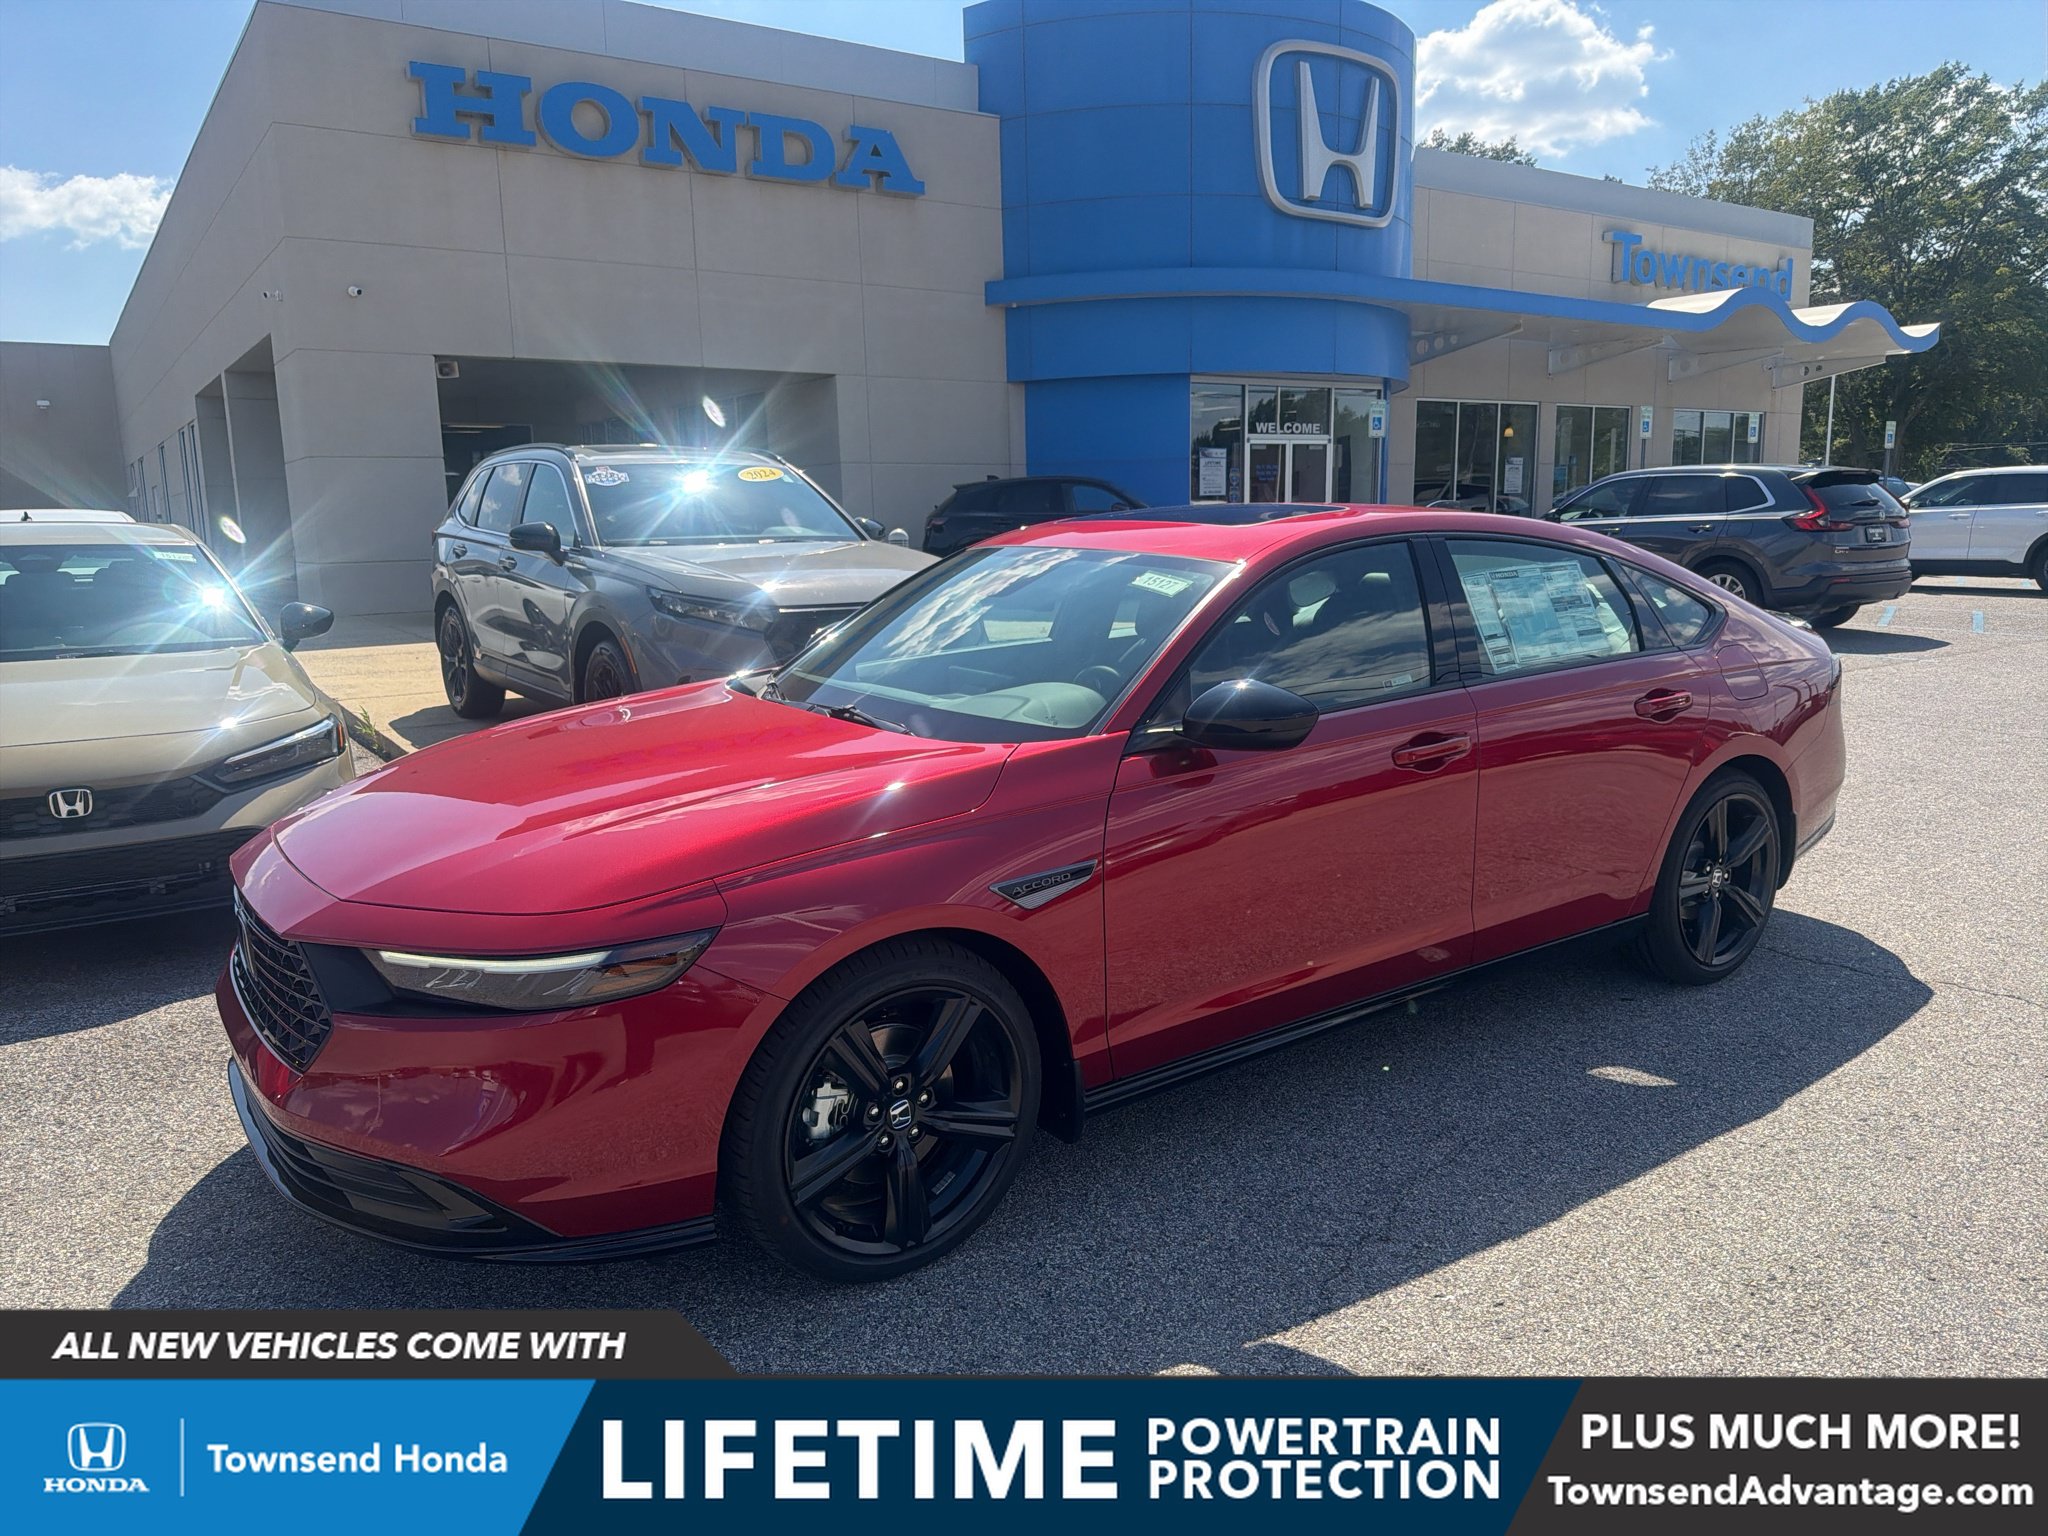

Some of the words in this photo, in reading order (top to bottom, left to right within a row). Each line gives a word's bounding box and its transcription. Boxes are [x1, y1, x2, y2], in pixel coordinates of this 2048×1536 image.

[407, 59, 926, 195] HONDA
[1608, 231, 1794, 301] Townsend
[1255, 422, 1321, 434] WELCOME
[1142, 575, 1180, 591] 15127
[1495, 571, 1518, 580] HONDA
[1012, 873, 1071, 896] ACCORD
